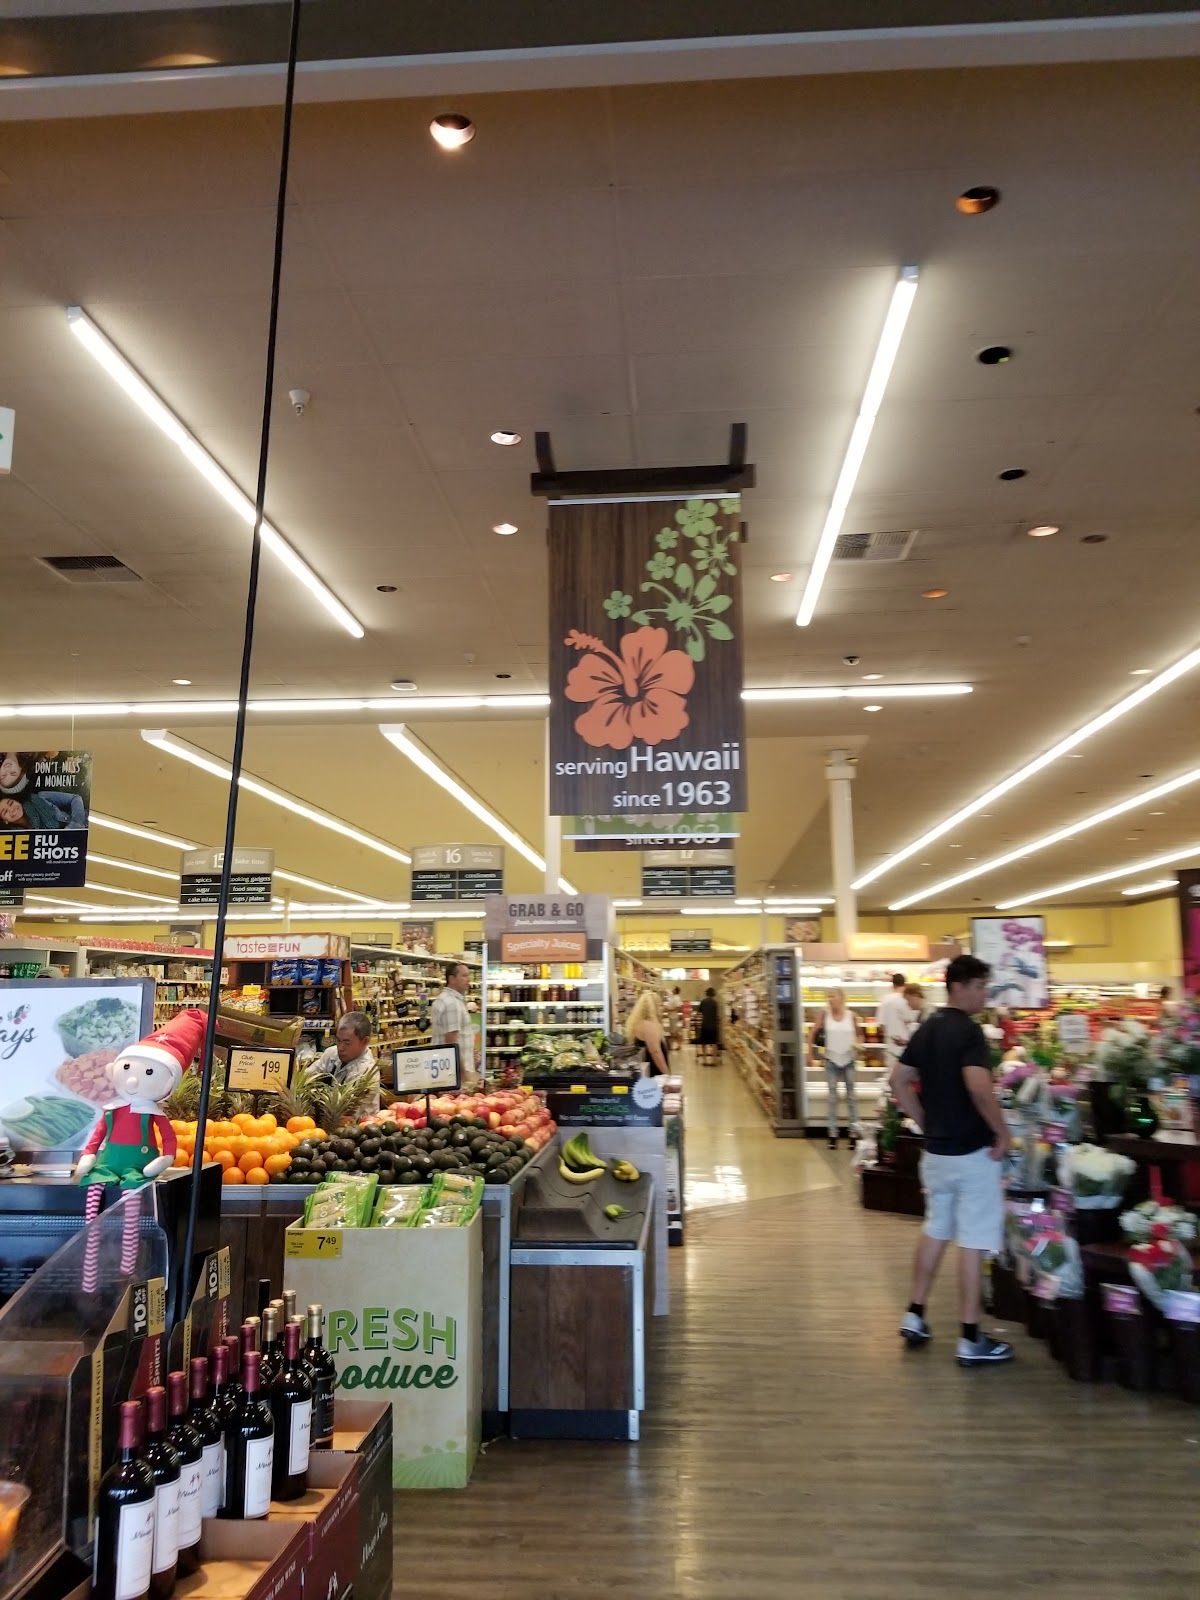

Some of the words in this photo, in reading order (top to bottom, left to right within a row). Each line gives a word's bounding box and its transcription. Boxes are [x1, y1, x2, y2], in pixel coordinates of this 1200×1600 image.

[35, 762, 58, 774] DON'T
[62, 761, 80, 773] MISS
[555, 758, 627, 778] serving
[630, 743, 740, 772] Hawaii
[35, 775, 40, 787] A
[45, 775, 78, 787] MOMENT.
[613, 791, 661, 807] since
[661, 781, 731, 806] 1963
[34, 834, 58, 847] FLU
[33, 847, 79, 859] SHOTS
[445, 848, 462, 863] 16
[508, 903, 546, 917] GRAB
[551, 903, 561, 916] &
[566, 902, 584, 916] GO
[237, 941, 267, 953] taste
[278, 942, 300, 953] FUN
[305, 1307, 457, 1360] RESH
[153, 1338, 161, 1386] SPIRITS
[335, 1356, 459, 1389] oduce
